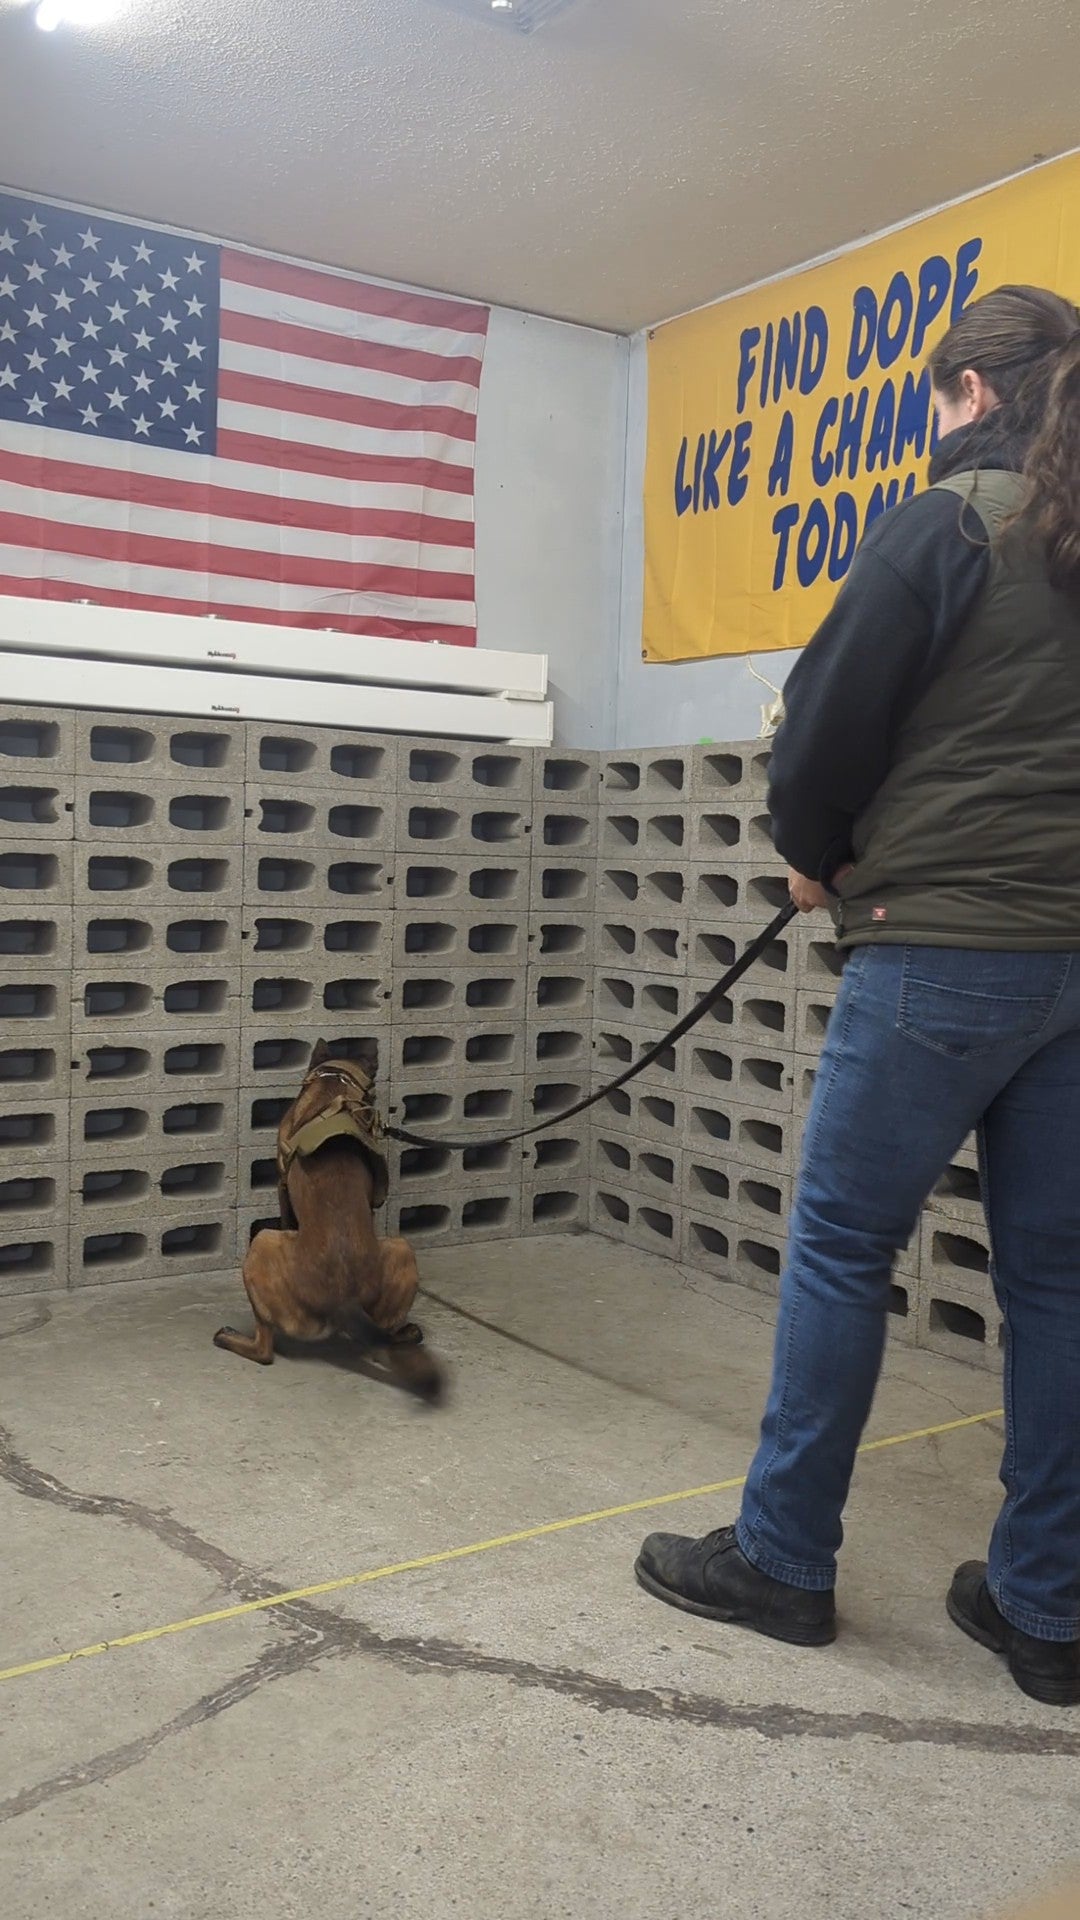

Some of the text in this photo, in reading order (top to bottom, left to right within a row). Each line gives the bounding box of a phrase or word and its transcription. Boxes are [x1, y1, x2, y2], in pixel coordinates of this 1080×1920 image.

[737, 237, 983, 414] FIND DOPE
[674, 366, 939, 517] LIKE A CHAM
[772, 472, 915, 592] TOD
